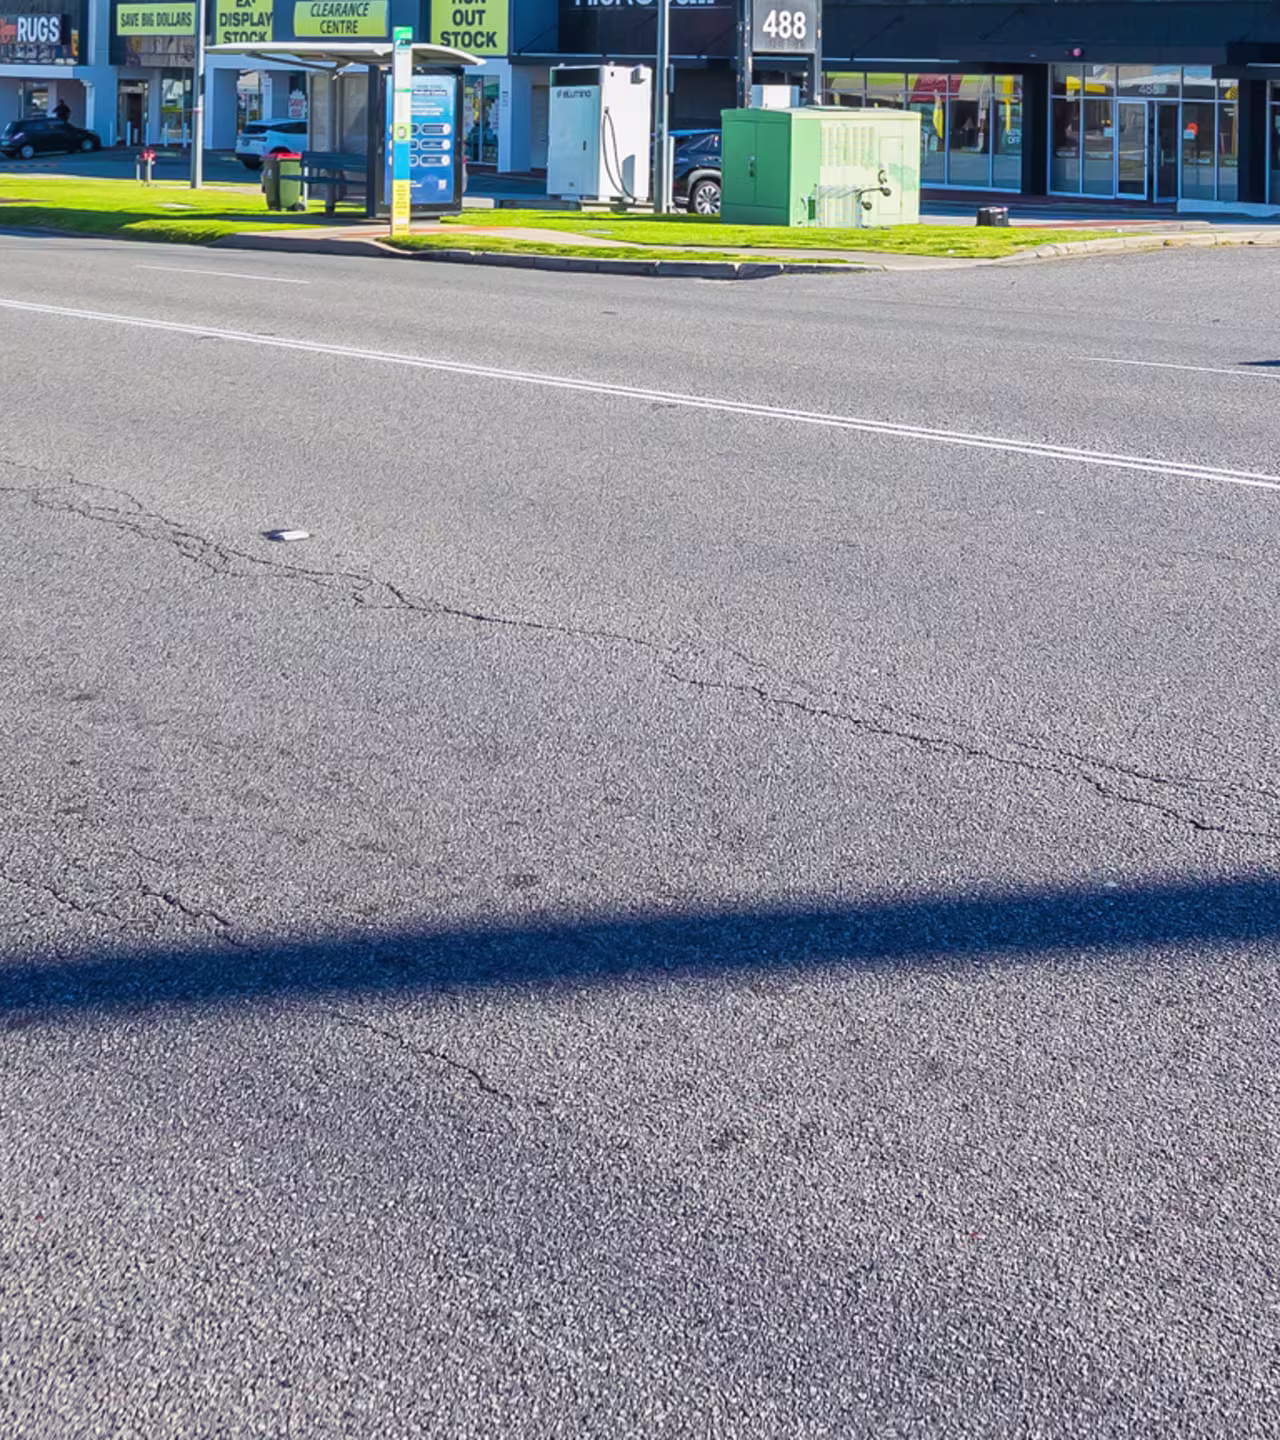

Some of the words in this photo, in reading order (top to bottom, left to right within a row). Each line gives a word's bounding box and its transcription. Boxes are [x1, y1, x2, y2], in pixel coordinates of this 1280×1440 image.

[310, 2, 370, 17] CLEARANCE
[121, 13, 139, 27] SAVE
[142, 12, 154, 27] BIG
[156, 12, 192, 27] DOLLARS
[220, 12, 273, 27] DISPLAY
[452, 10, 486, 26] OUT
[762, 10, 806, 39] 488
[18, 17, 59, 42] RUGS
[320, 20, 358, 34] CENTRE
[223, 31, 267, 43] STOCK
[440, 31, 497, 48] STOCK
